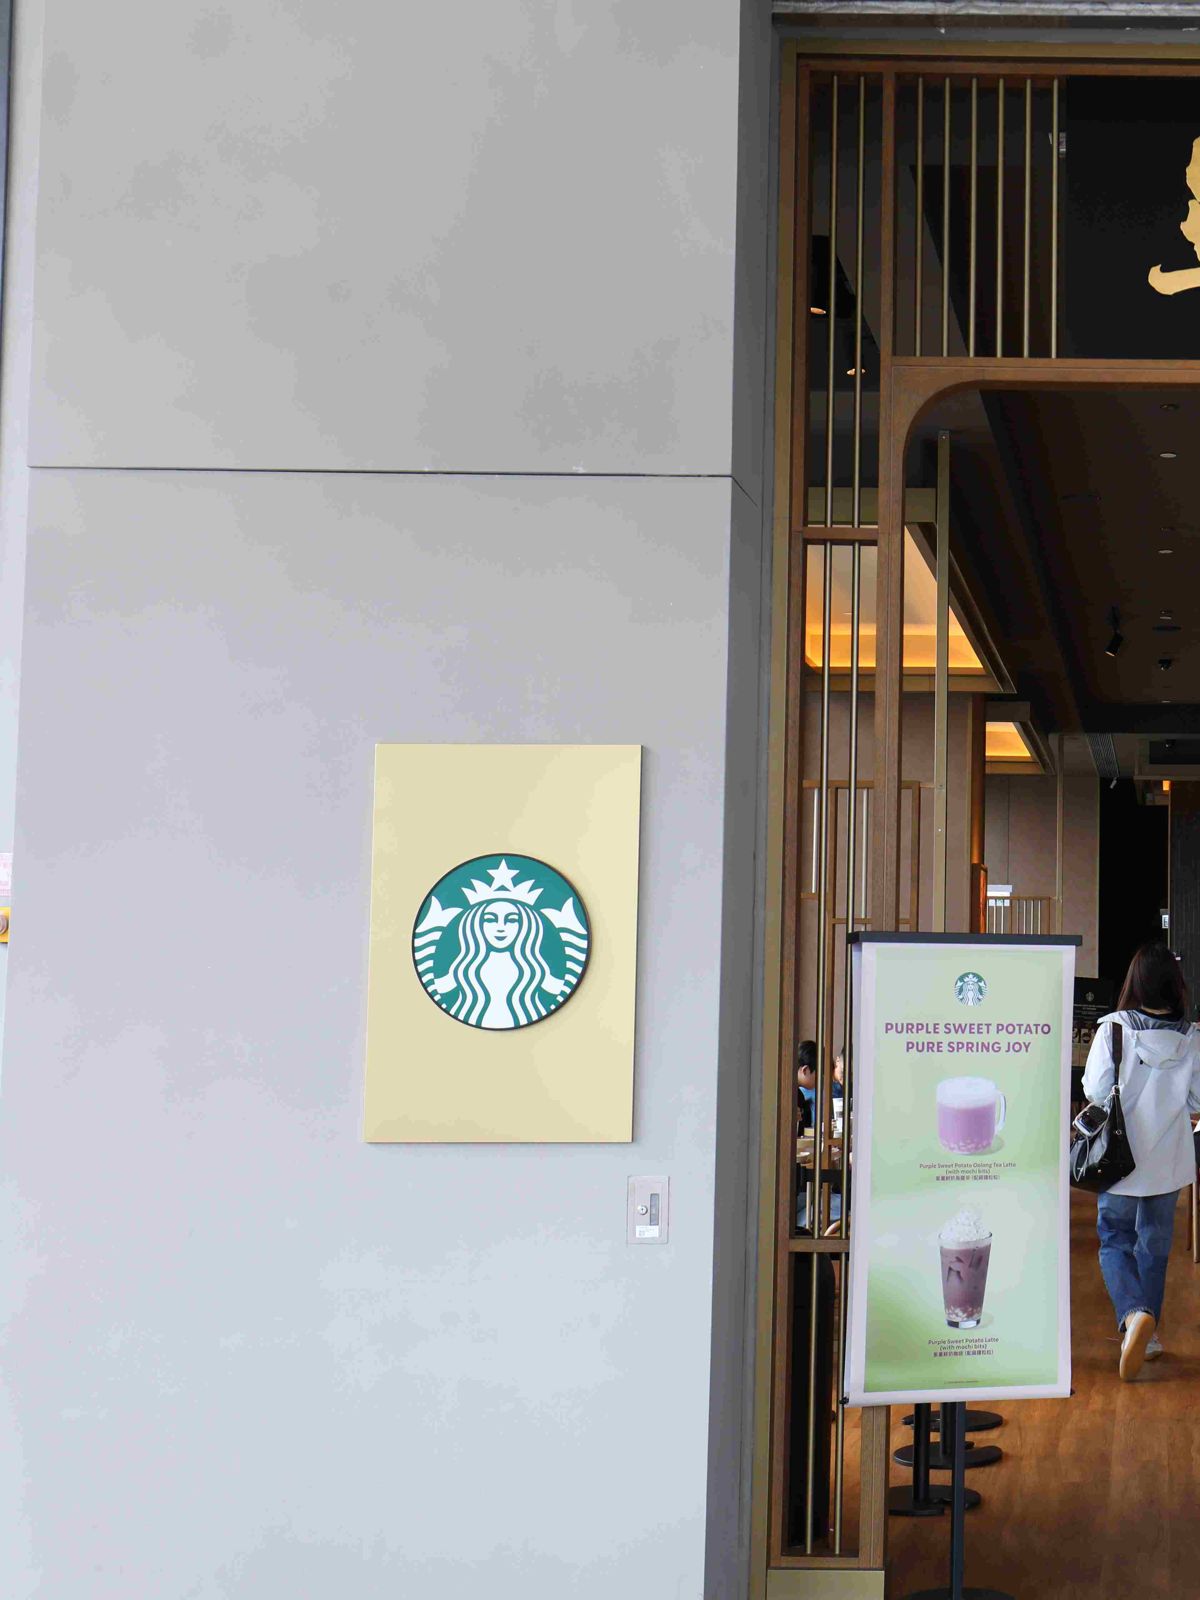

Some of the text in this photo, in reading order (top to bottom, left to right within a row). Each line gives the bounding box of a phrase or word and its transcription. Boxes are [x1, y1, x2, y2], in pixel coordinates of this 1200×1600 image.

[884, 1022, 1052, 1035] PURPLE SWEET POTATO
[906, 1041, 1031, 1053] PURE SPRING JOY
